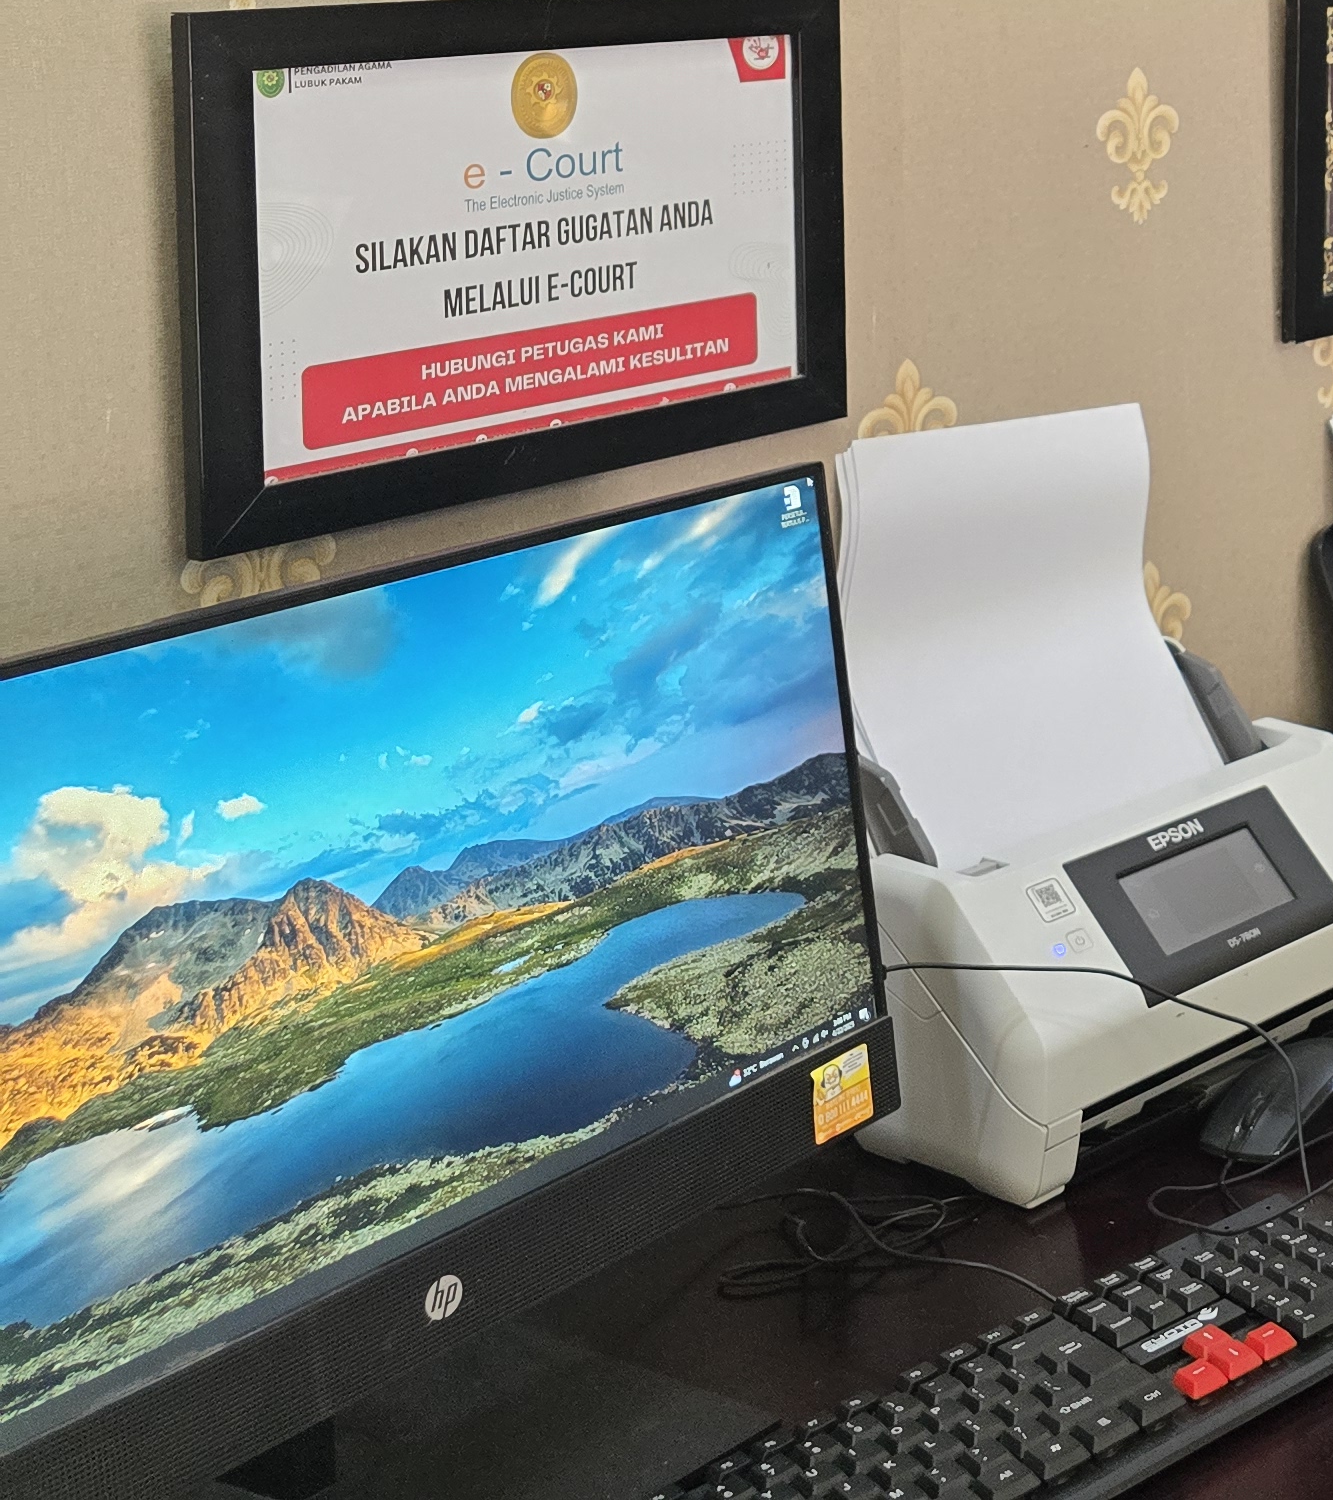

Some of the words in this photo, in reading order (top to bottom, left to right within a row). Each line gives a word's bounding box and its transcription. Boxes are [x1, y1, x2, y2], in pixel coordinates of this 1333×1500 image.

[294, 64, 356, 76] PENGADILAN
[357, 61, 392, 71] AGAMA
[294, 78, 327, 89] LUBUK
[329, 76, 362, 86] PAKAM
[463, 163, 486, 189] e
[526, 141, 624, 182] Court
[465, 198, 486, 213] The
[490, 190, 544, 210] Electronic
[546, 186, 584, 203] Justice
[586, 183, 625, 201] System
[355, 231, 457, 274] SILAKAN
[464, 219, 551, 260] DAFTAR
[557, 205, 653, 246] GUGATAN
[659, 198, 714, 232] ANDA
[443, 274, 541, 318] MELALUI
[547, 261, 638, 302] E-COURT
[421, 350, 516, 380] HUBUNGI
[521, 333, 609, 366] PETUGAS
[613, 323, 664, 347] KAMI
[341, 393, 437, 424] APABILA
[442, 382, 500, 406] ANDA
[505, 357, 626, 393] MENGALAMI
[629, 337, 730, 371] KESULITAN
[1146, 817, 1205, 852] EPSON
[429, 1276, 460, 1320] hp
[1143, 1389, 1162, 1402] Ctrl
